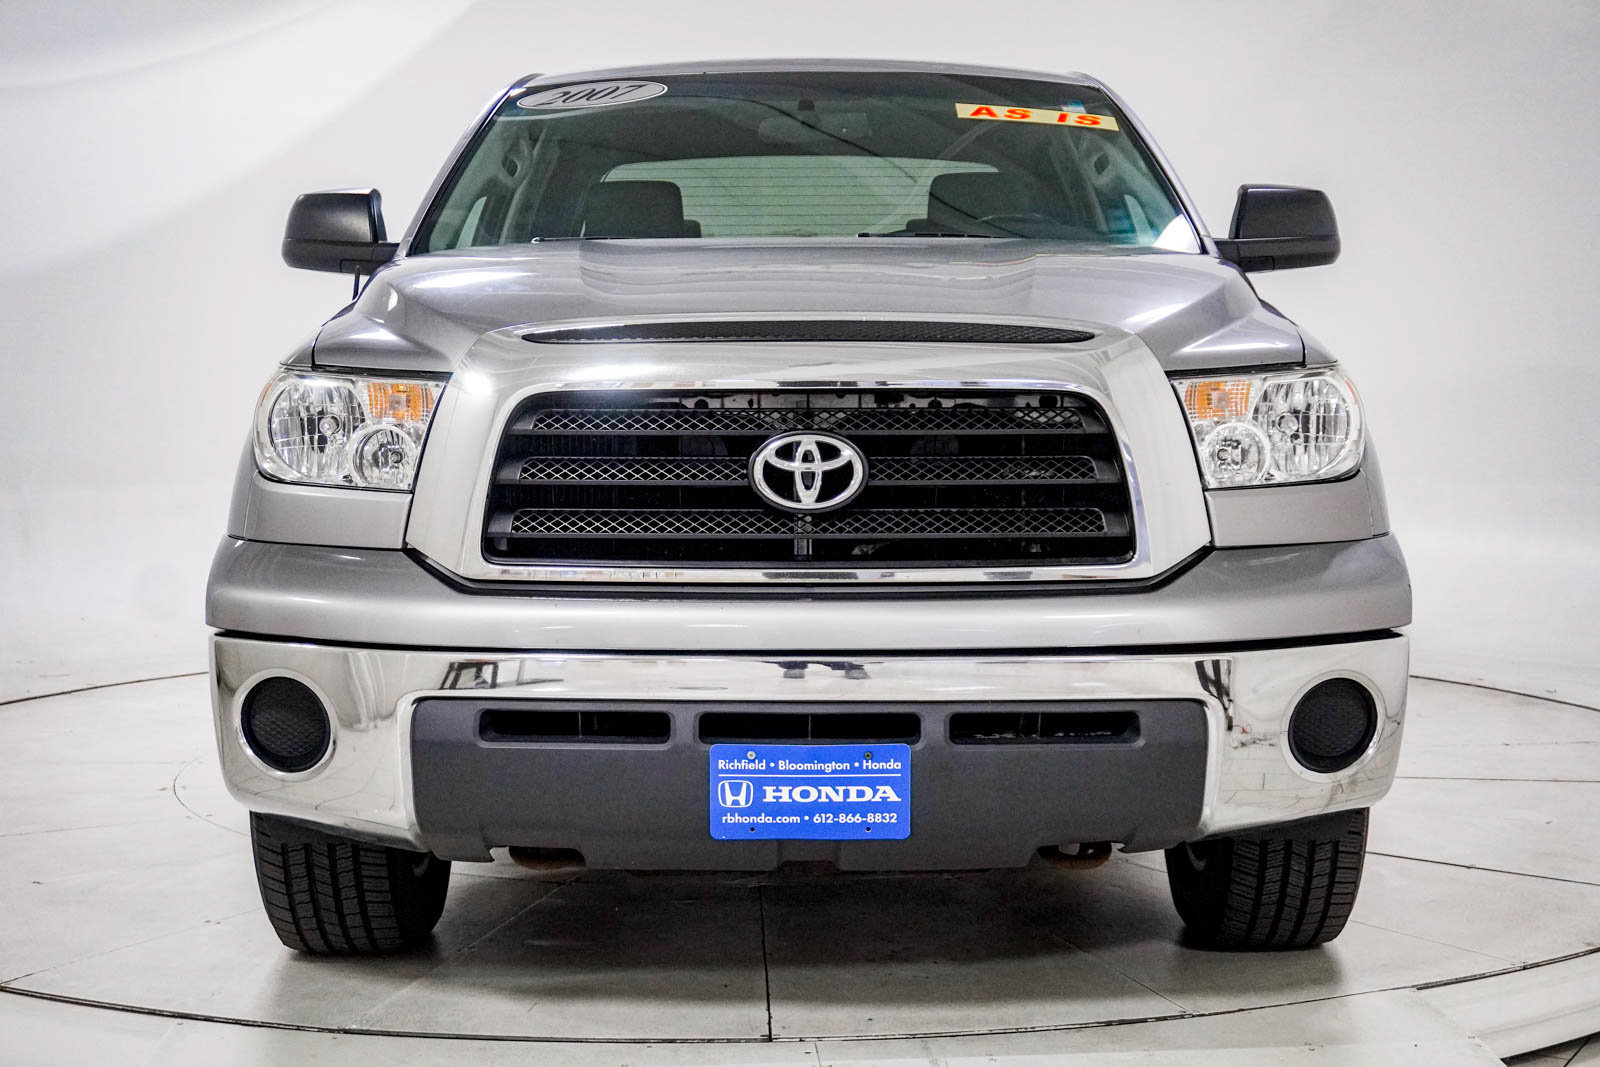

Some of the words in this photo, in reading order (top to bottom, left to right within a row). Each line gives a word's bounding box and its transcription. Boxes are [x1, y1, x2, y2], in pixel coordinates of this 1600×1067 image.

[534, 84, 648, 106] 2007
[969, 105, 1032, 120] AS
[1056, 112, 1102, 126] IS
[718, 759, 766, 770] Richfield
[778, 760, 850, 773] Bloomington
[862, 759, 901, 770] Honda
[762, 785, 902, 803] HONDA
[722, 812, 800, 824] rbhonda.com
[813, 812, 897, 824] 612-866-8832
